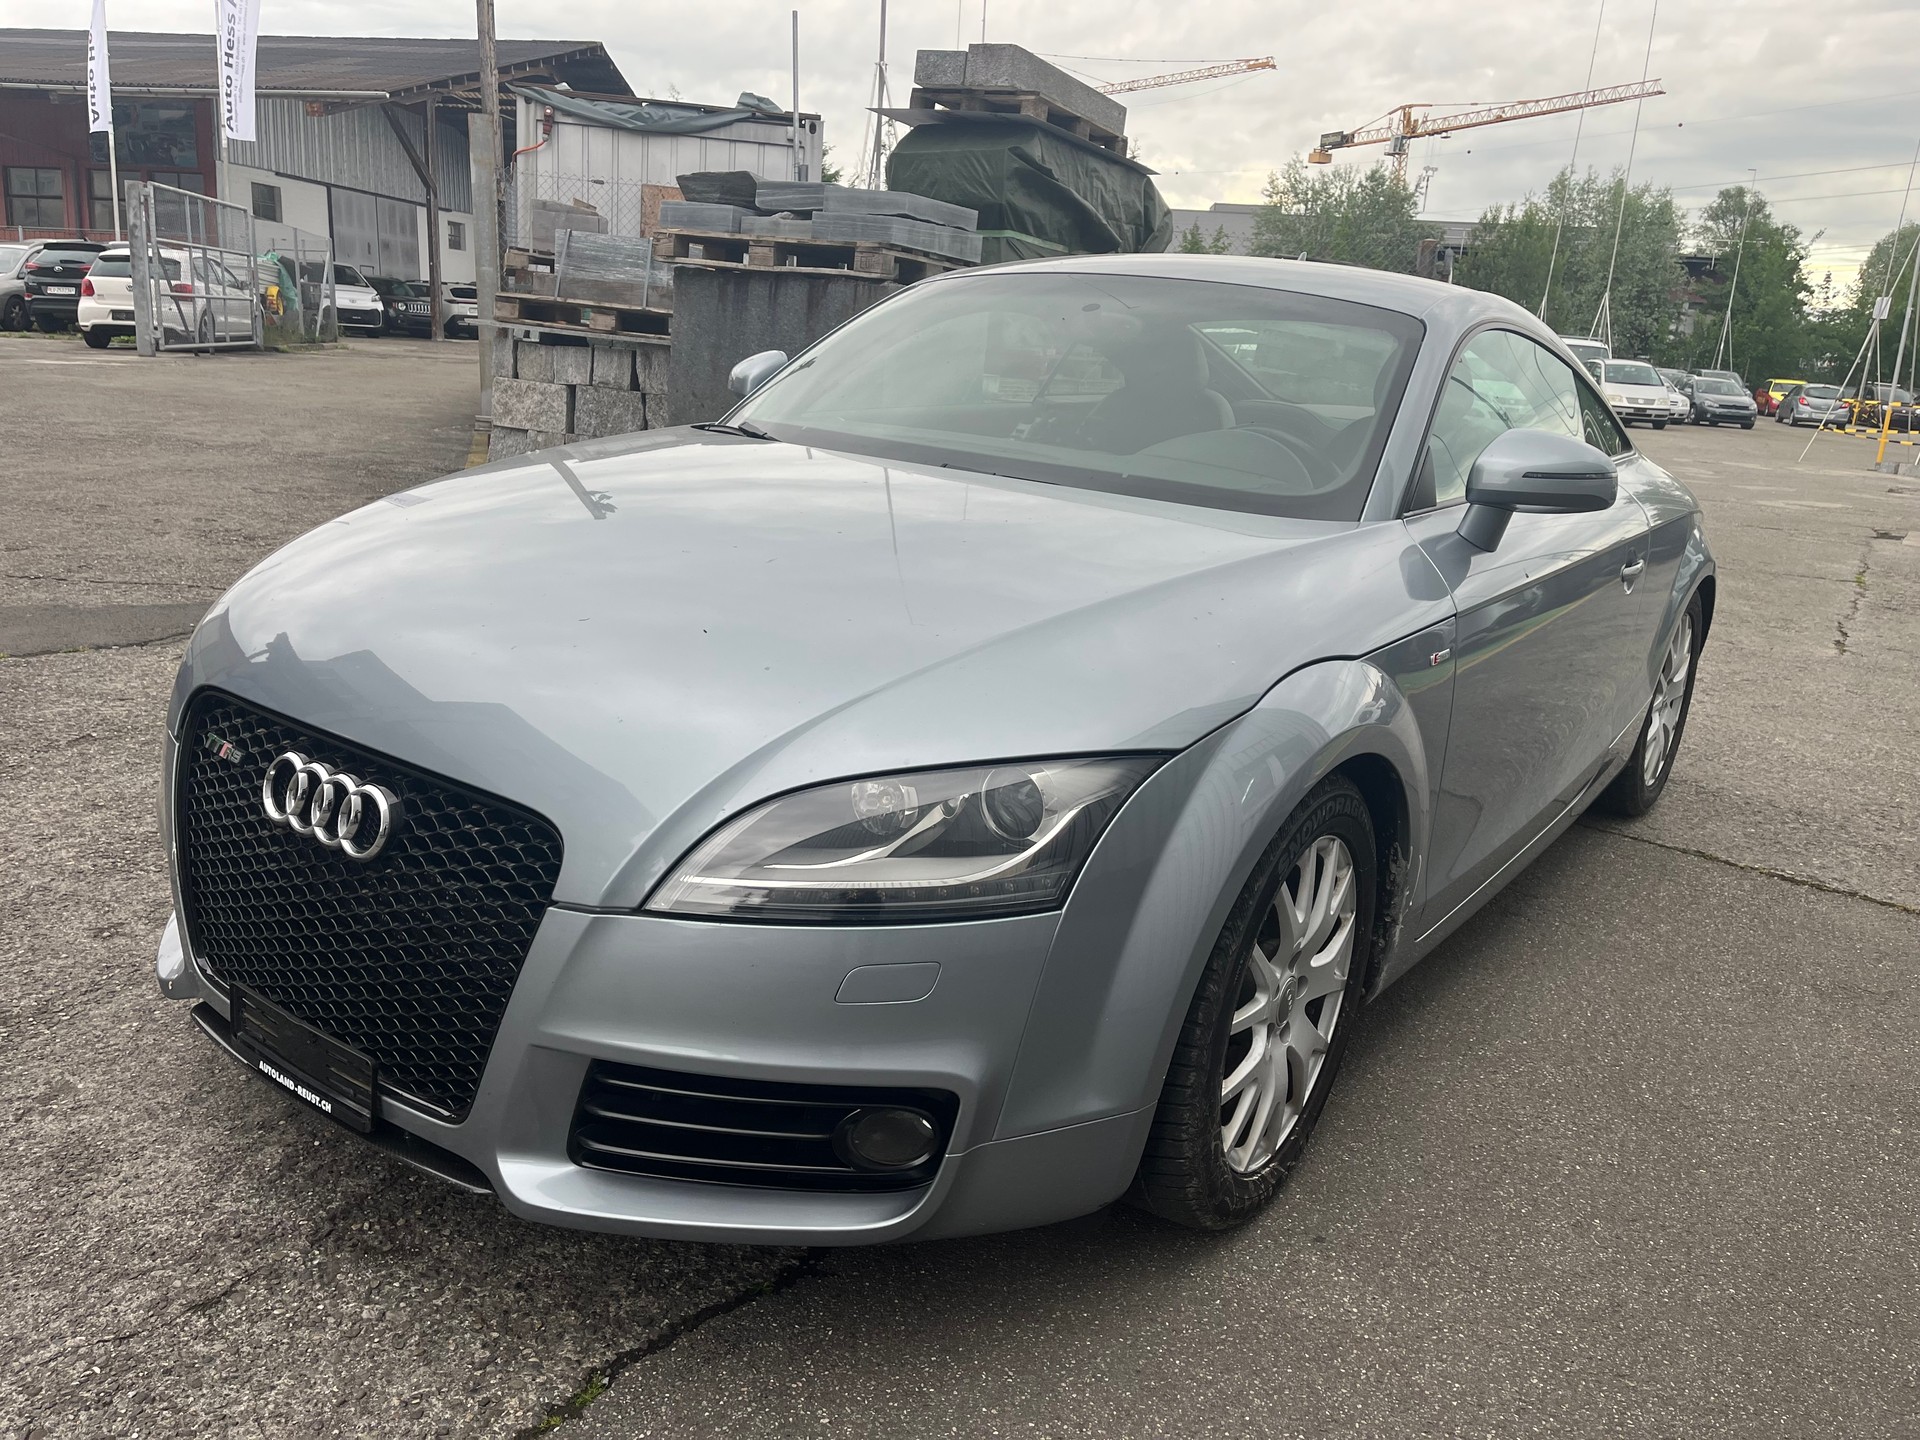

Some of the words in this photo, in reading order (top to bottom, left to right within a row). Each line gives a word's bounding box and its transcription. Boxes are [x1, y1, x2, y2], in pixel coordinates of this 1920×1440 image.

[224, 13, 236, 69] Hess
[225, 75, 234, 133] Auto
[259, 1060, 332, 1114] AUTOLAND-REUST.CH
